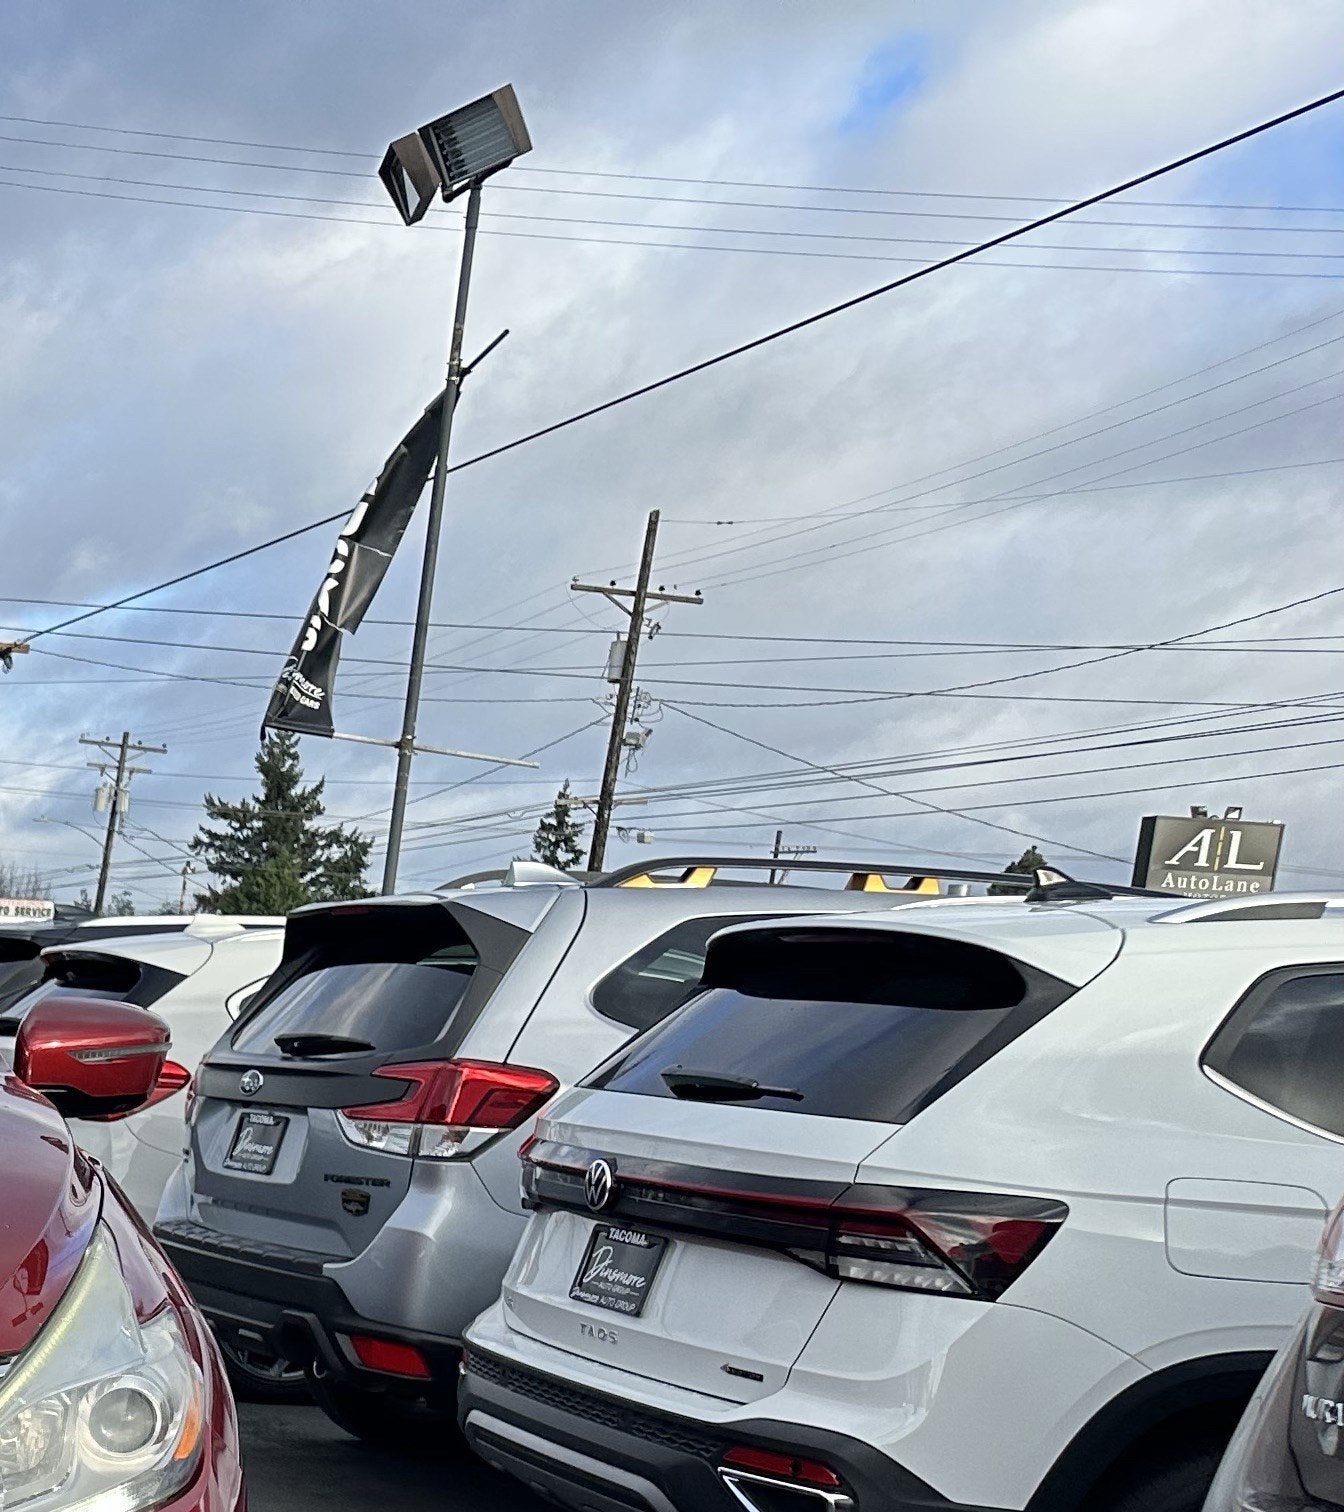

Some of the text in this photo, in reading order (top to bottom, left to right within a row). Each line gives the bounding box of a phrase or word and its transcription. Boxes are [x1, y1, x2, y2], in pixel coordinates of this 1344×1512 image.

[1161, 872, 1261, 894] AutoLane
[608, 1227, 649, 1247] TACOMA
[580, 1322, 618, 1345] TAOS
